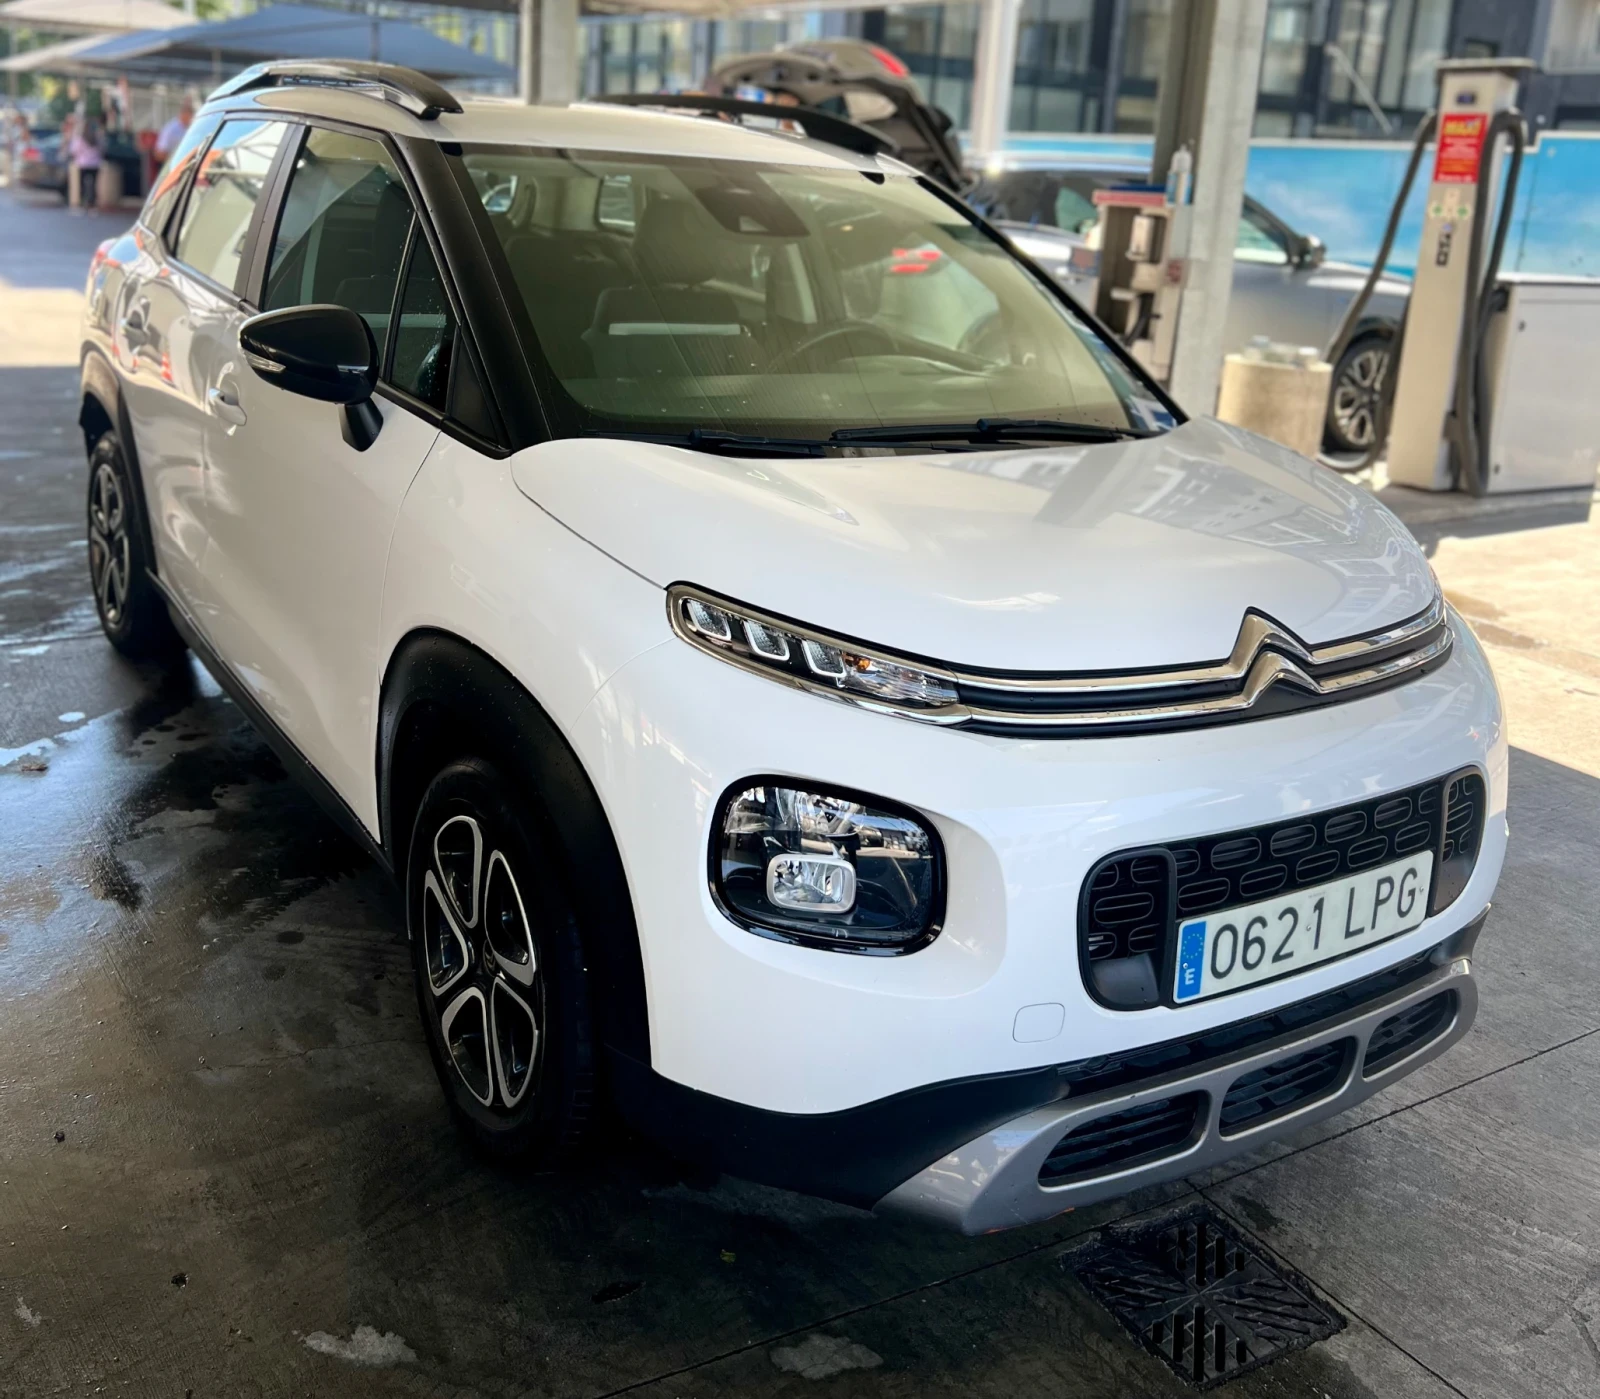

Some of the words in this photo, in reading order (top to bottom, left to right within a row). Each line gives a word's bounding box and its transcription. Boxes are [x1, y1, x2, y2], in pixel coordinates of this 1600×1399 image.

[1210, 896, 1325, 980] 0621
[1344, 867, 1418, 940] LPG
[1184, 967, 1196, 986] E
